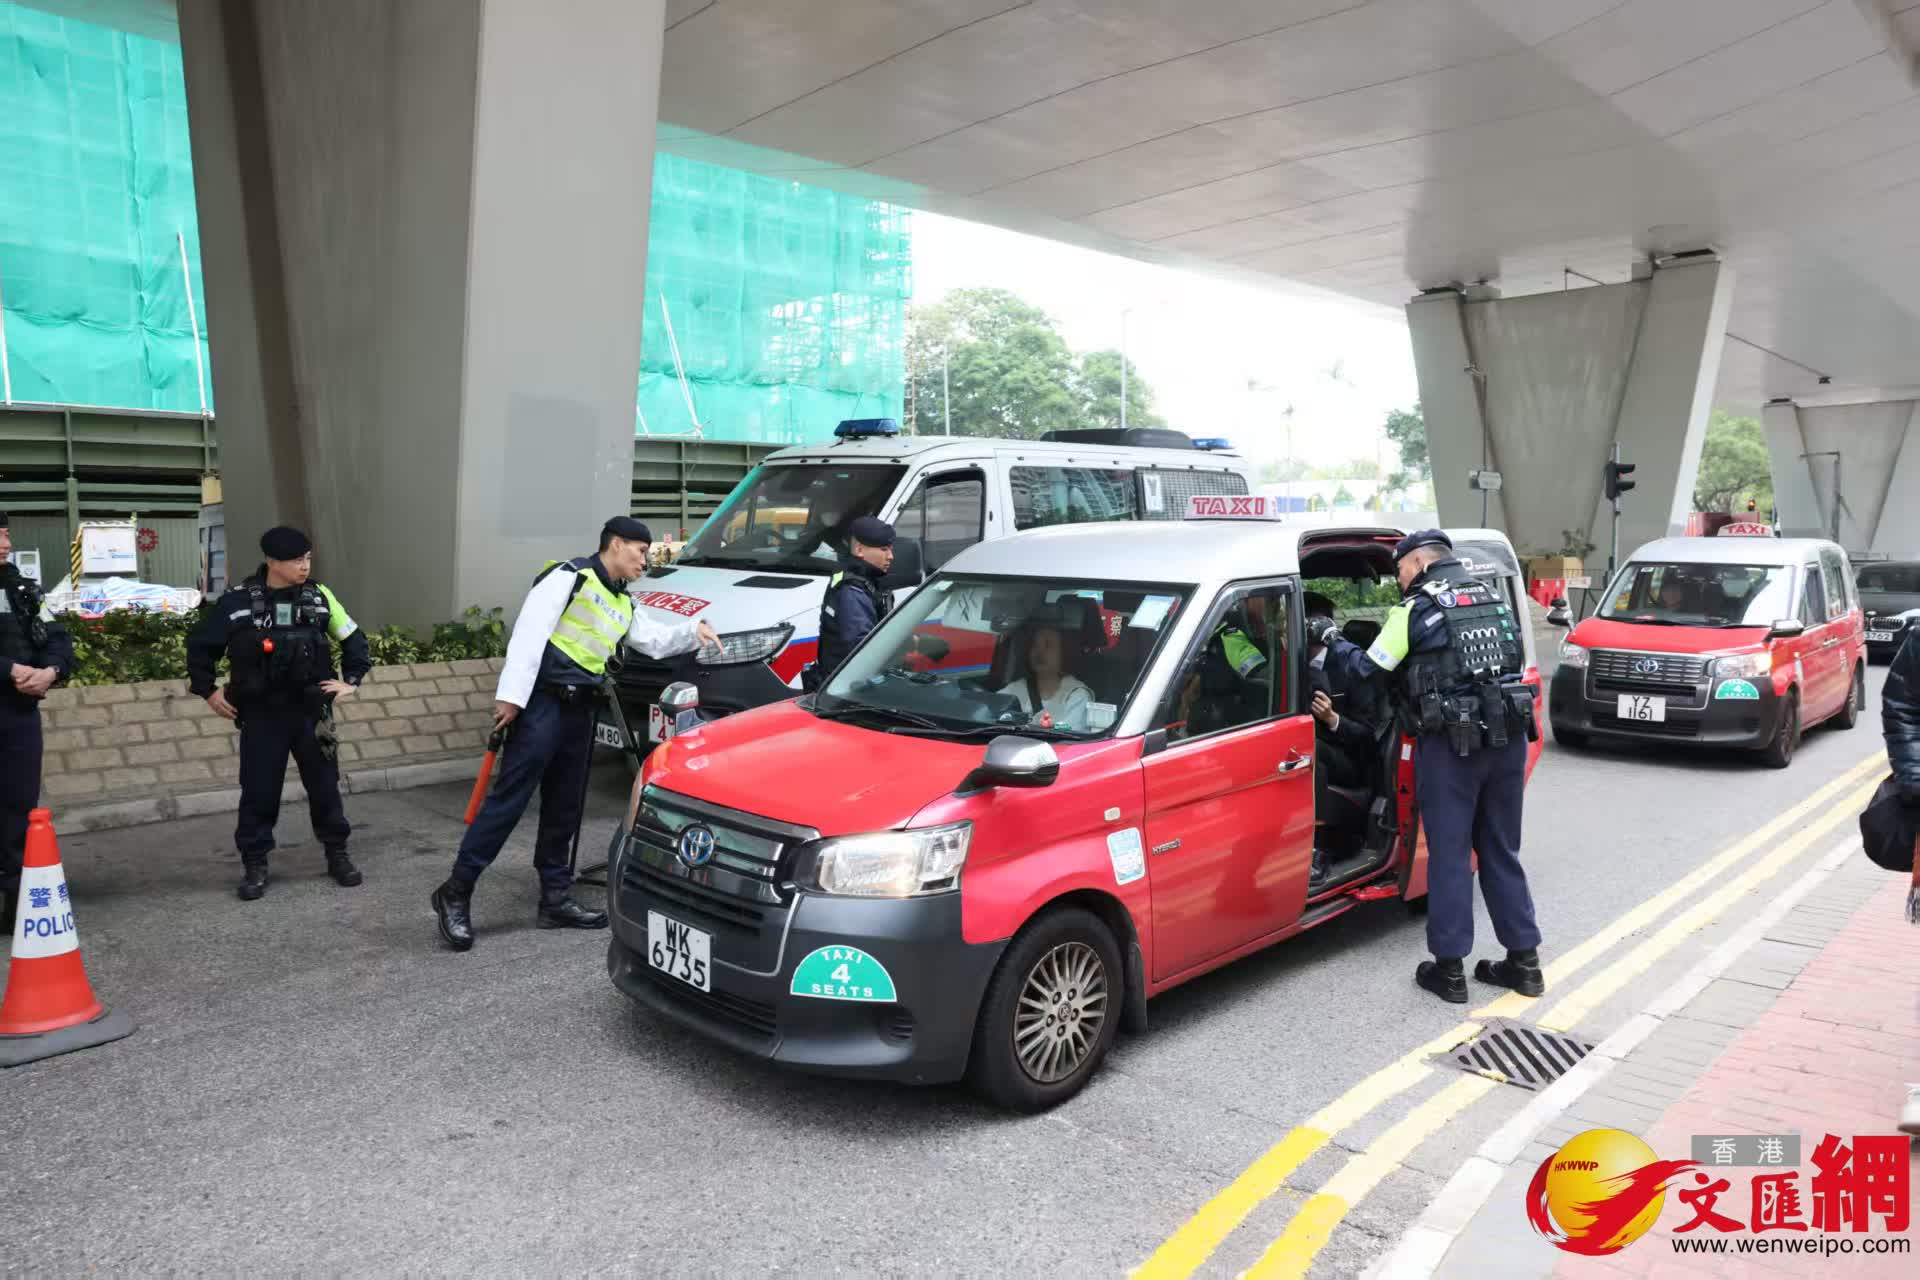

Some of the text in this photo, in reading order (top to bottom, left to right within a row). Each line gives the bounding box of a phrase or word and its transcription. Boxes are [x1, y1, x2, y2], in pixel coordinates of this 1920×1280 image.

[1193, 497, 1265, 515] TAXI
[1728, 524, 1766, 534] TAXI
[1632, 696, 1650, 709] YZ
[1628, 706, 1653, 721] 1161
[24, 912, 74, 939] POLIC
[665, 918, 691, 956] WK
[652, 941, 706, 988] 6735
[820, 948, 864, 964] TAXI
[831, 963, 851, 984] 4
[811, 983, 873, 998] SEATS
